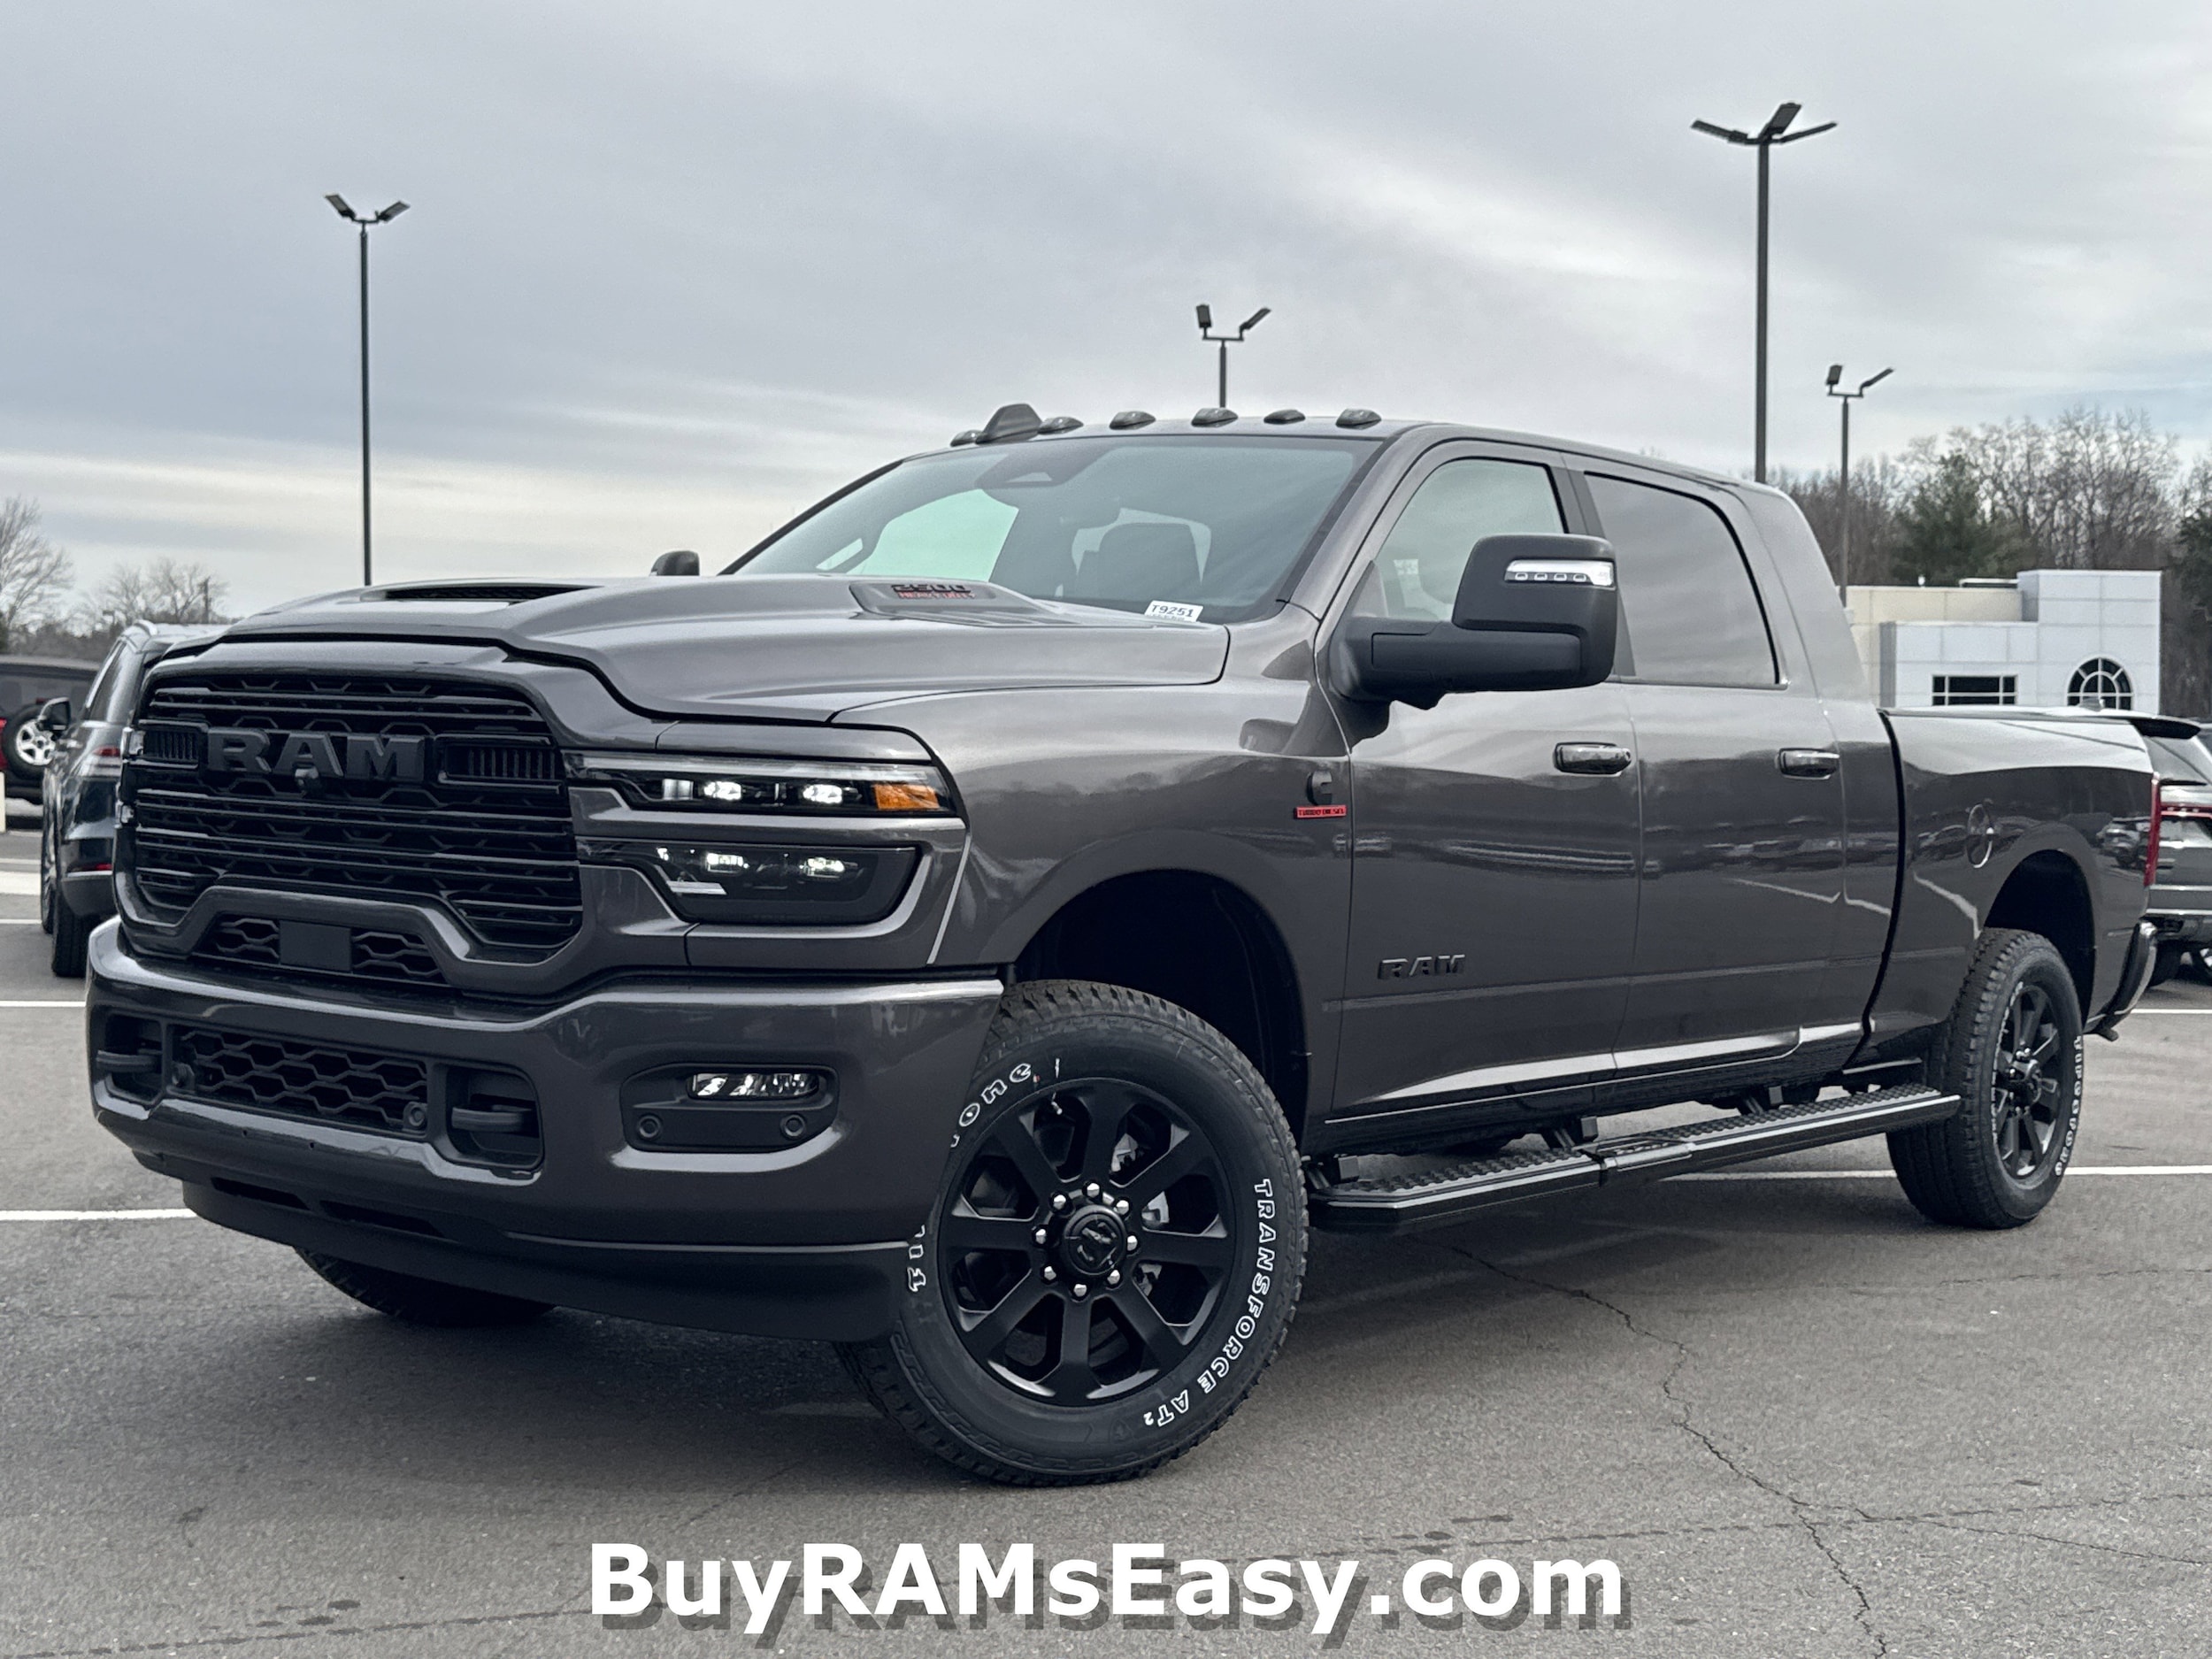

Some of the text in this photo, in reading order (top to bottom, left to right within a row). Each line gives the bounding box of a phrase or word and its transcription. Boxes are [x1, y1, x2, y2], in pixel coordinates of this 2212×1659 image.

[1151, 604, 1194, 618] T9251
[207, 727, 425, 784] RAM
[1378, 953, 1466, 979] RAM
[1196, 1178, 1277, 1394] TRANSFORCE
